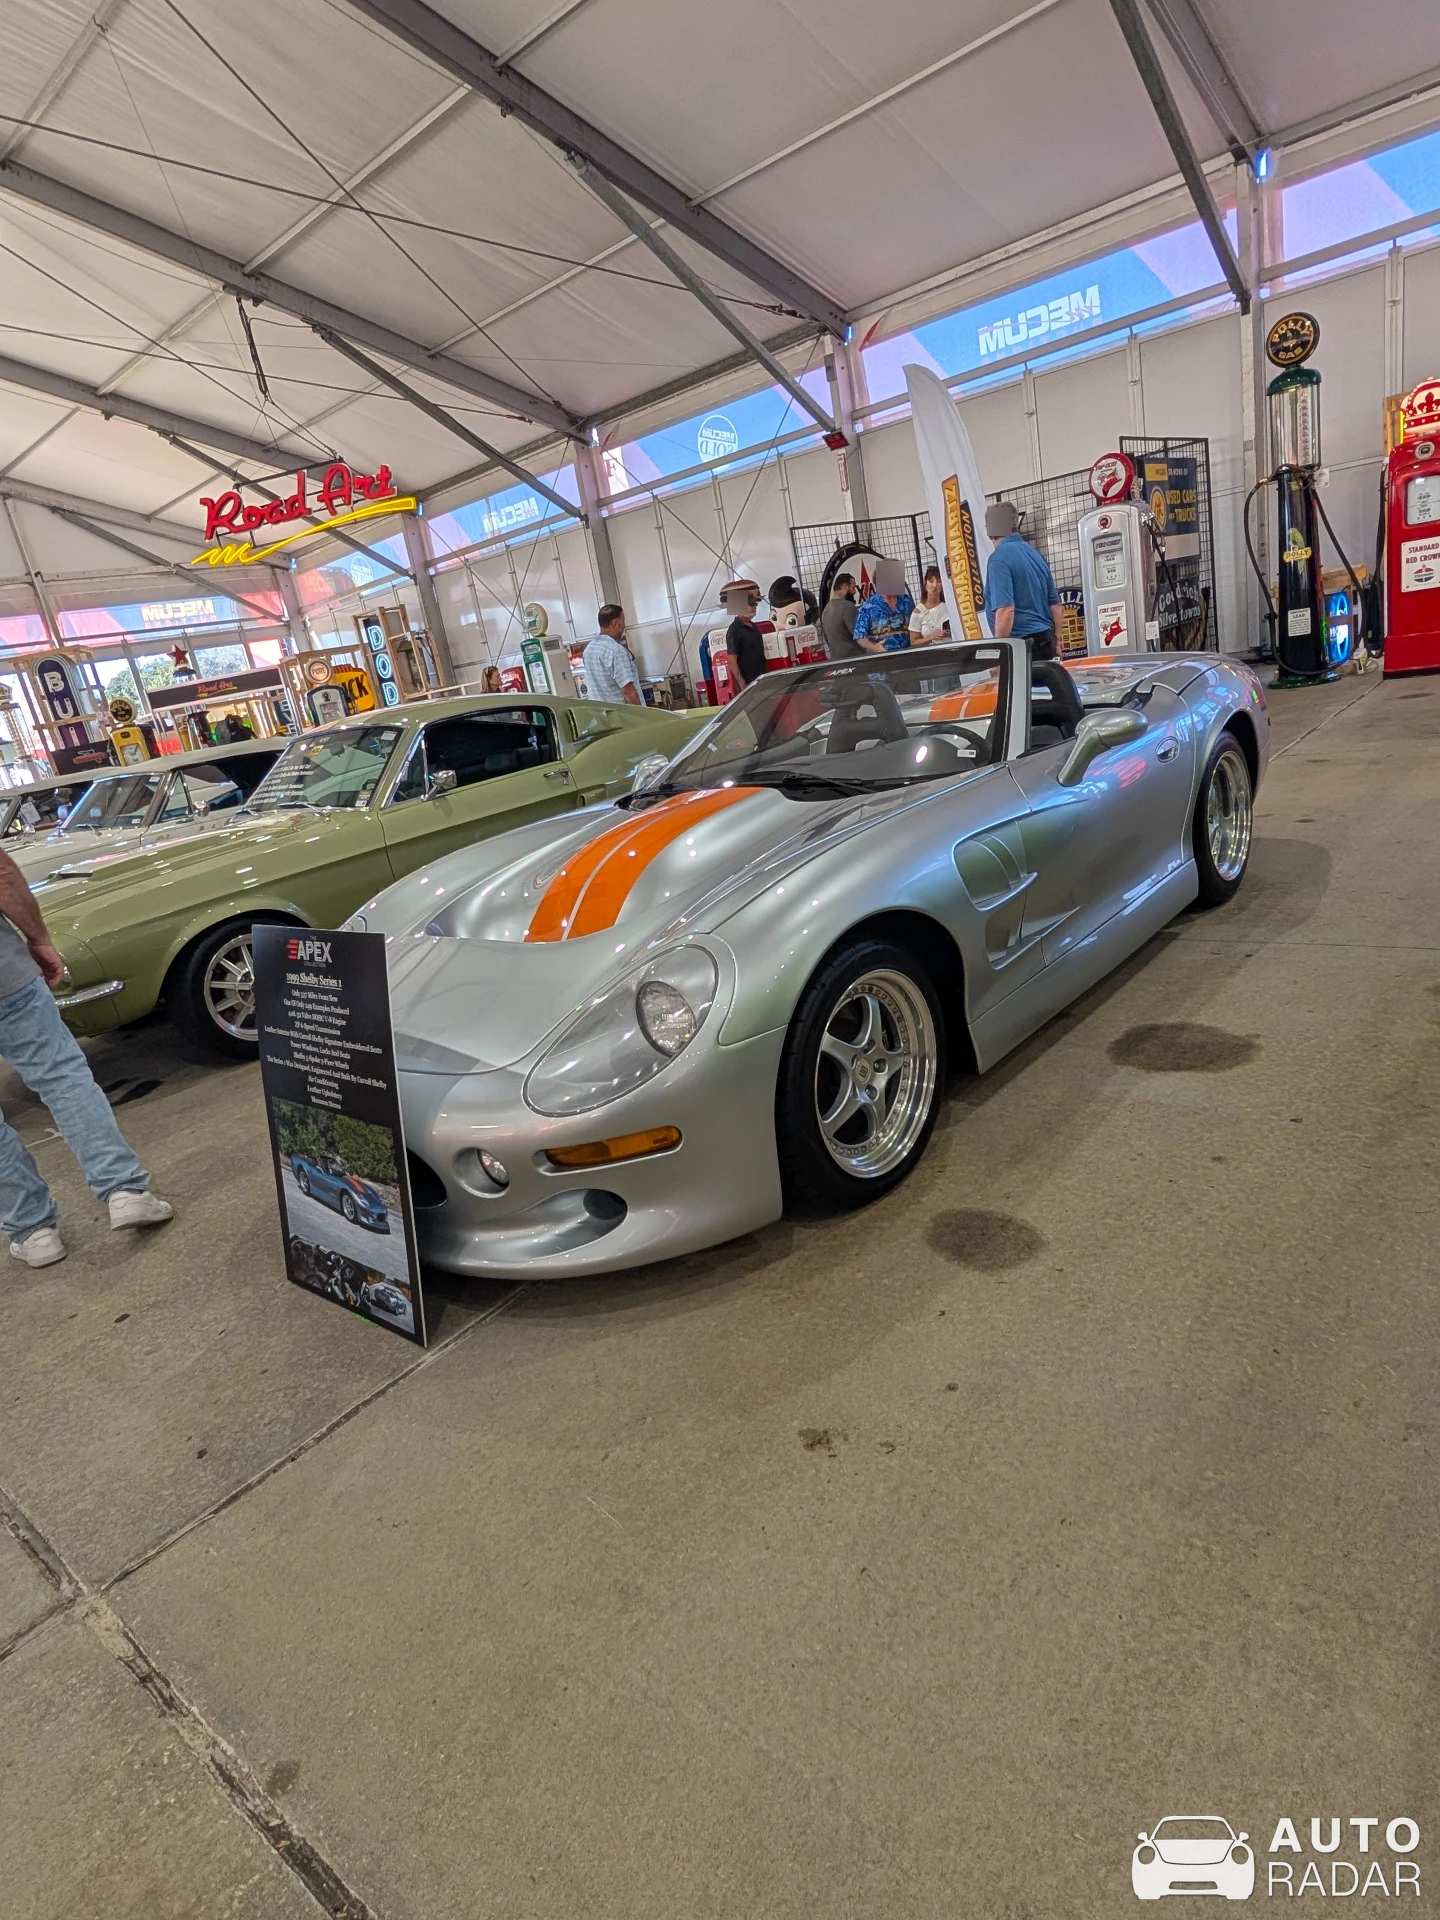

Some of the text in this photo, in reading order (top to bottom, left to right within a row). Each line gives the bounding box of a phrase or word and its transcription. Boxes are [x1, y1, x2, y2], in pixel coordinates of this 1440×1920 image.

[1271, 320, 1313, 342] POLLY
[1278, 346, 1303, 359] GAS
[200, 463, 398, 541] Road Art
[1166, 489, 1197, 505] USED CARS
[1175, 507, 1197, 522] TRUCKS
[1285, 549, 1309, 559] POLLY
[1408, 542, 1440, 554] STANDARD
[944, 484, 979, 640] THOMAS-MARTZ
[961, 509, 984, 605] COLLECTION
[1405, 556, 1418, 564] RED
[1158, 605, 1201, 628] Silvetowns
[297, 940, 333, 963] APEX
[286, 972, 342, 987] 1999 Shelby Series 1
[313, 1003, 330, 1013] Examples
[331, 1005, 349, 1015] Produced
[265, 1025, 277, 1034] Leather
[312, 1034, 324, 1044] Shelby
[343, 1040, 370, 1051] Embroidered
[370, 1045, 382, 1054] Seats
[294, 1052, 305, 1061] Shelby
[372, 1079, 387, 1090] Shelby
